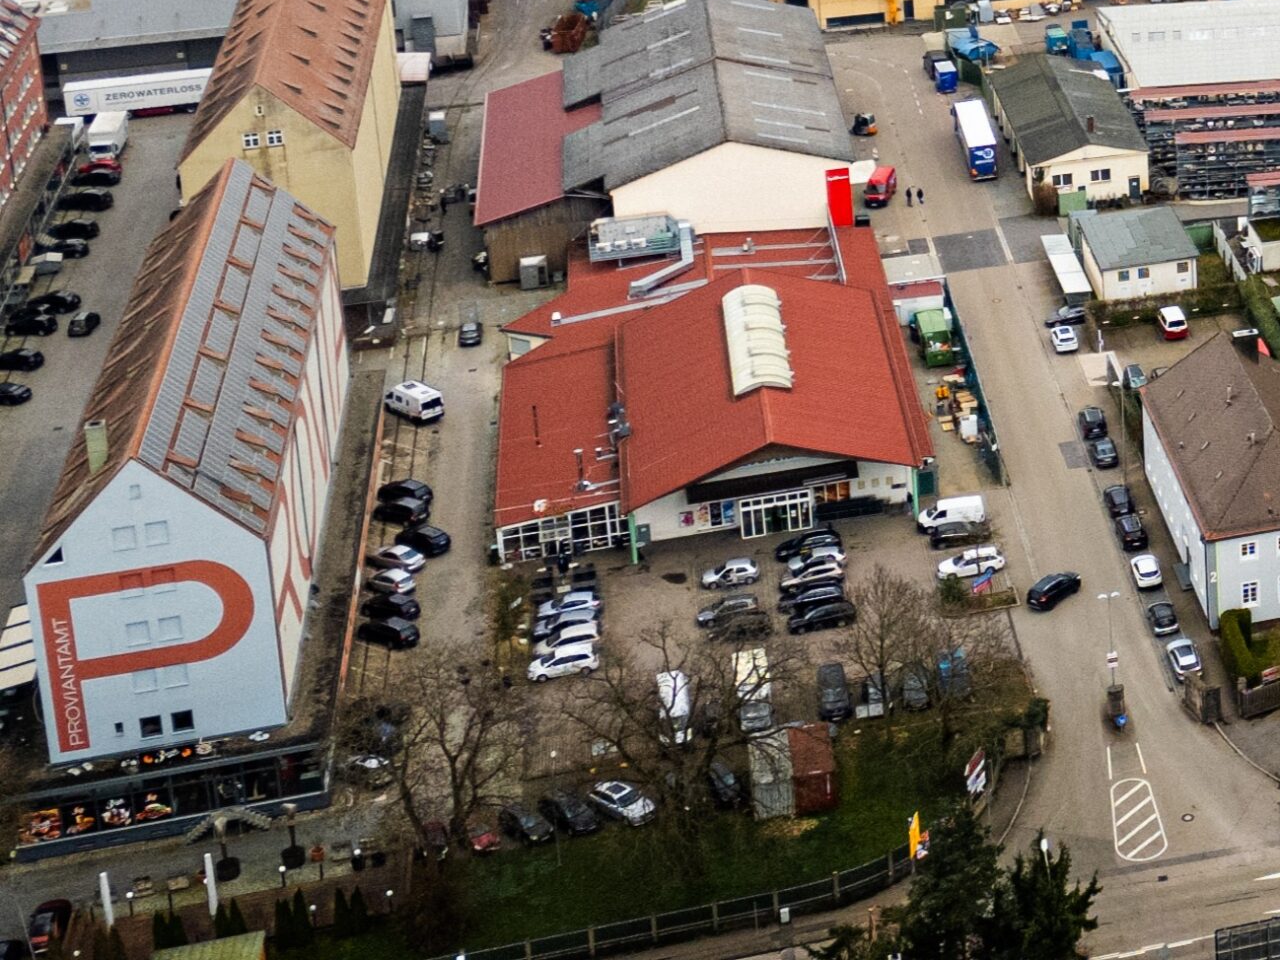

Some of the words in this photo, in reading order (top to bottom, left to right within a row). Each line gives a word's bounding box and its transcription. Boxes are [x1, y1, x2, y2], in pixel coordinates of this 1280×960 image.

[105, 84, 202, 101] ZEROWATERLOSS
[1210, 571, 1217, 584] 2
[36, 559, 255, 753] P
[51, 618, 84, 746] PROVIANTAMT
